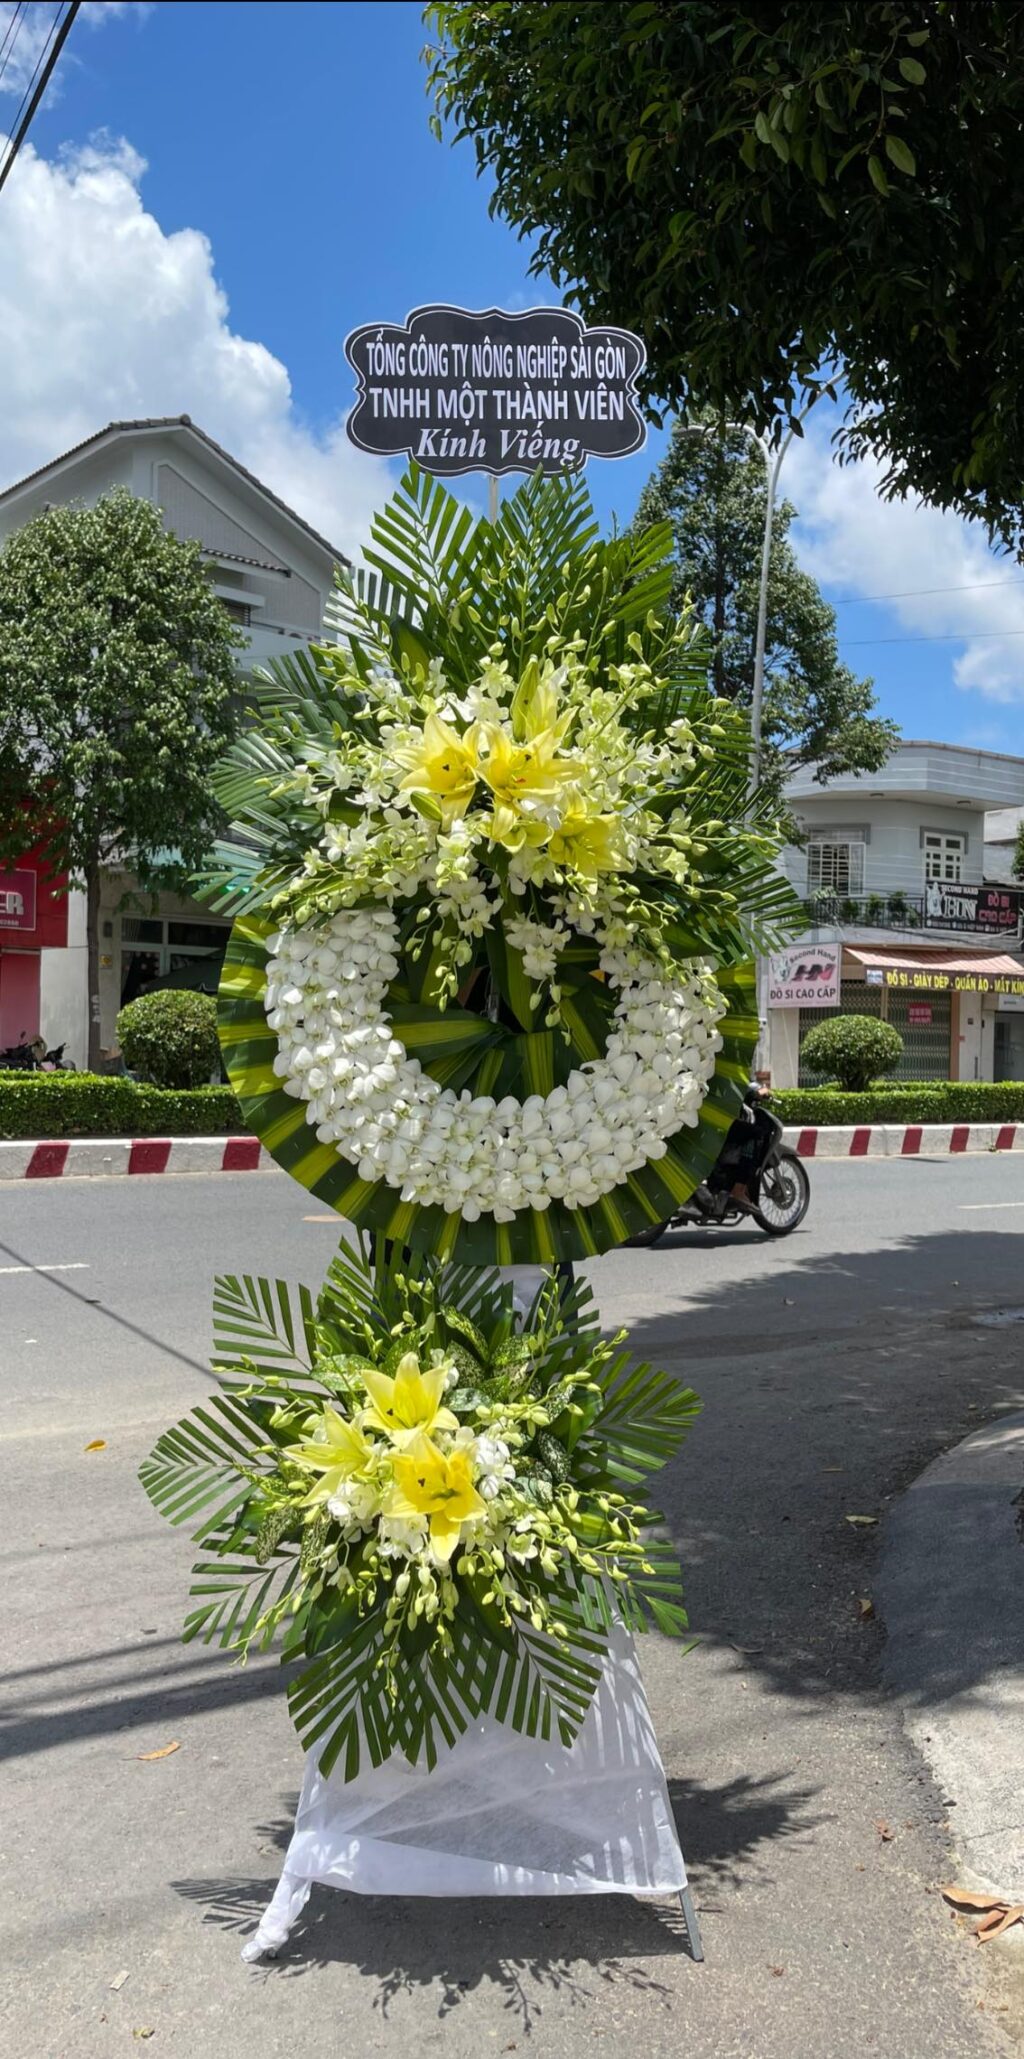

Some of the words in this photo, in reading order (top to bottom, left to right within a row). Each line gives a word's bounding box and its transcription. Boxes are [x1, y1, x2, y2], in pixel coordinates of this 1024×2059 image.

[366, 328, 405, 376] TỔNG
[409, 334, 448, 377] CÔNG
[451, 344, 470, 378] TY
[472, 336, 513, 378] NÔNG
[516, 336, 567, 386] NGHIỆP
[570, 337, 592, 379] SÀI
[595, 337, 626, 379] GÒN
[369, 388, 430, 418] TNHH
[437, 381, 488, 426] MỘT
[493, 382, 568, 420] THÀNH
[574, 383, 624, 420] VIÊN
[415, 428, 487, 458] Kính
[500, 420, 580, 470] Viếng
[817, 949, 836, 962] Hand
[785, 989, 794, 999] SI
[796, 988, 815, 999] CAO
